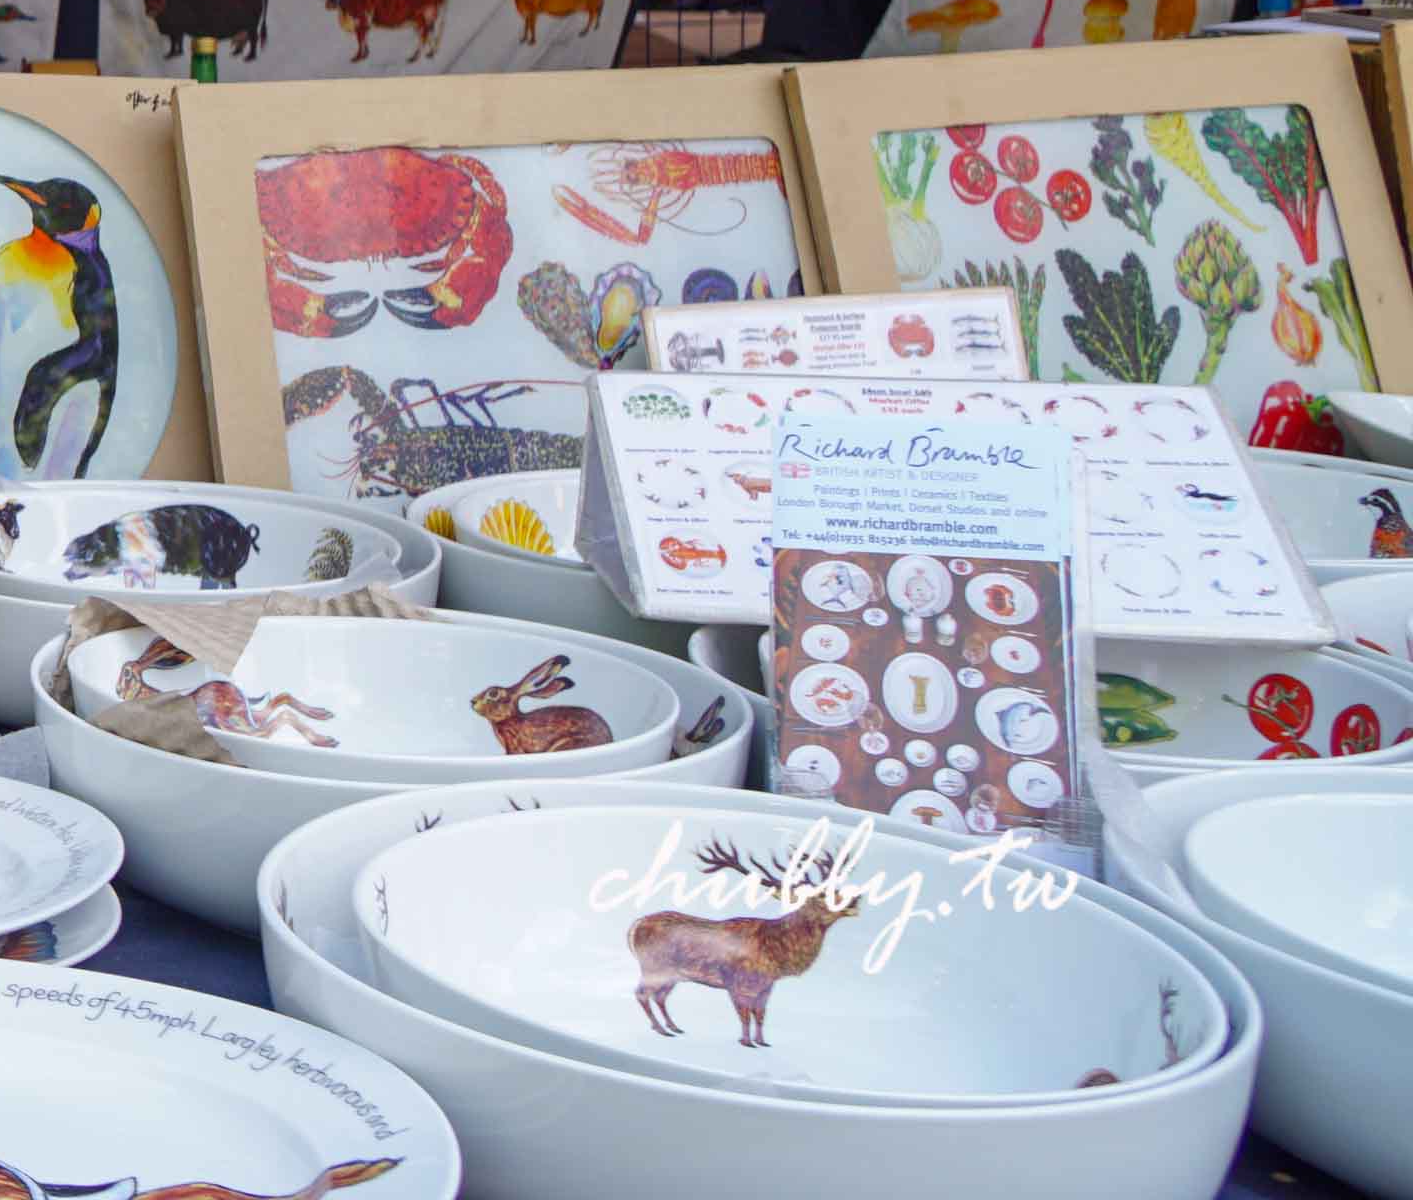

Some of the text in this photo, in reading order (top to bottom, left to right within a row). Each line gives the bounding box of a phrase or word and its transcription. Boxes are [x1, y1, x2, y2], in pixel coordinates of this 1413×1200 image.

[779, 433, 1043, 469] Richard Bramble
[815, 467, 860, 479] BRITISH
[863, 468, 903, 479] ARTIST
[922, 470, 981, 482] DESIGNER
[812, 484, 1008, 502] Paintings Prints Ceramics Textiles
[777, 496, 1047, 518] London Borough Market, Dorset Studios and online
[825, 515, 998, 536] www.richardbramble.com
[4, 978, 85, 1010] speeds
[85, 988, 120, 1024] of
[201, 1014, 280, 1072] Largley
